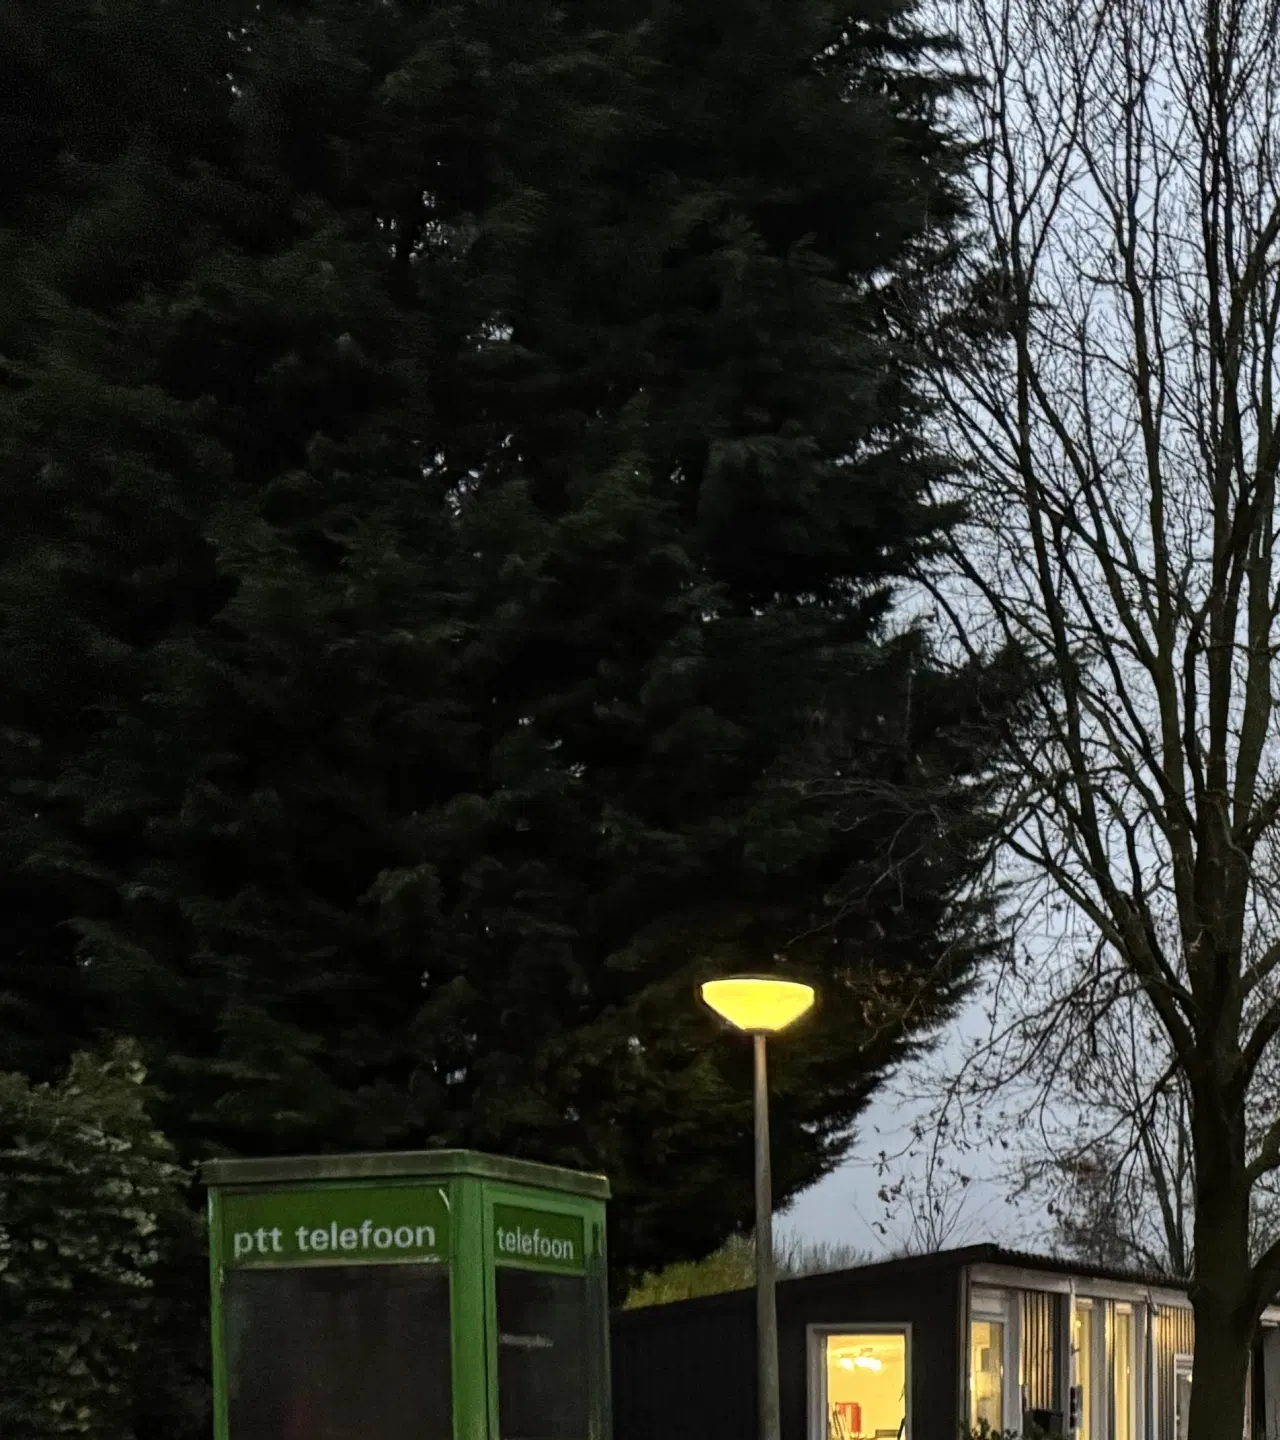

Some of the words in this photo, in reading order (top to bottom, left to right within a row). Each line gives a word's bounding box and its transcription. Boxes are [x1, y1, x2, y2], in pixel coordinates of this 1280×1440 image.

[233, 1226, 283, 1259] ptt
[294, 1219, 436, 1251] telefoon
[496, 1226, 575, 1260] telefoon
